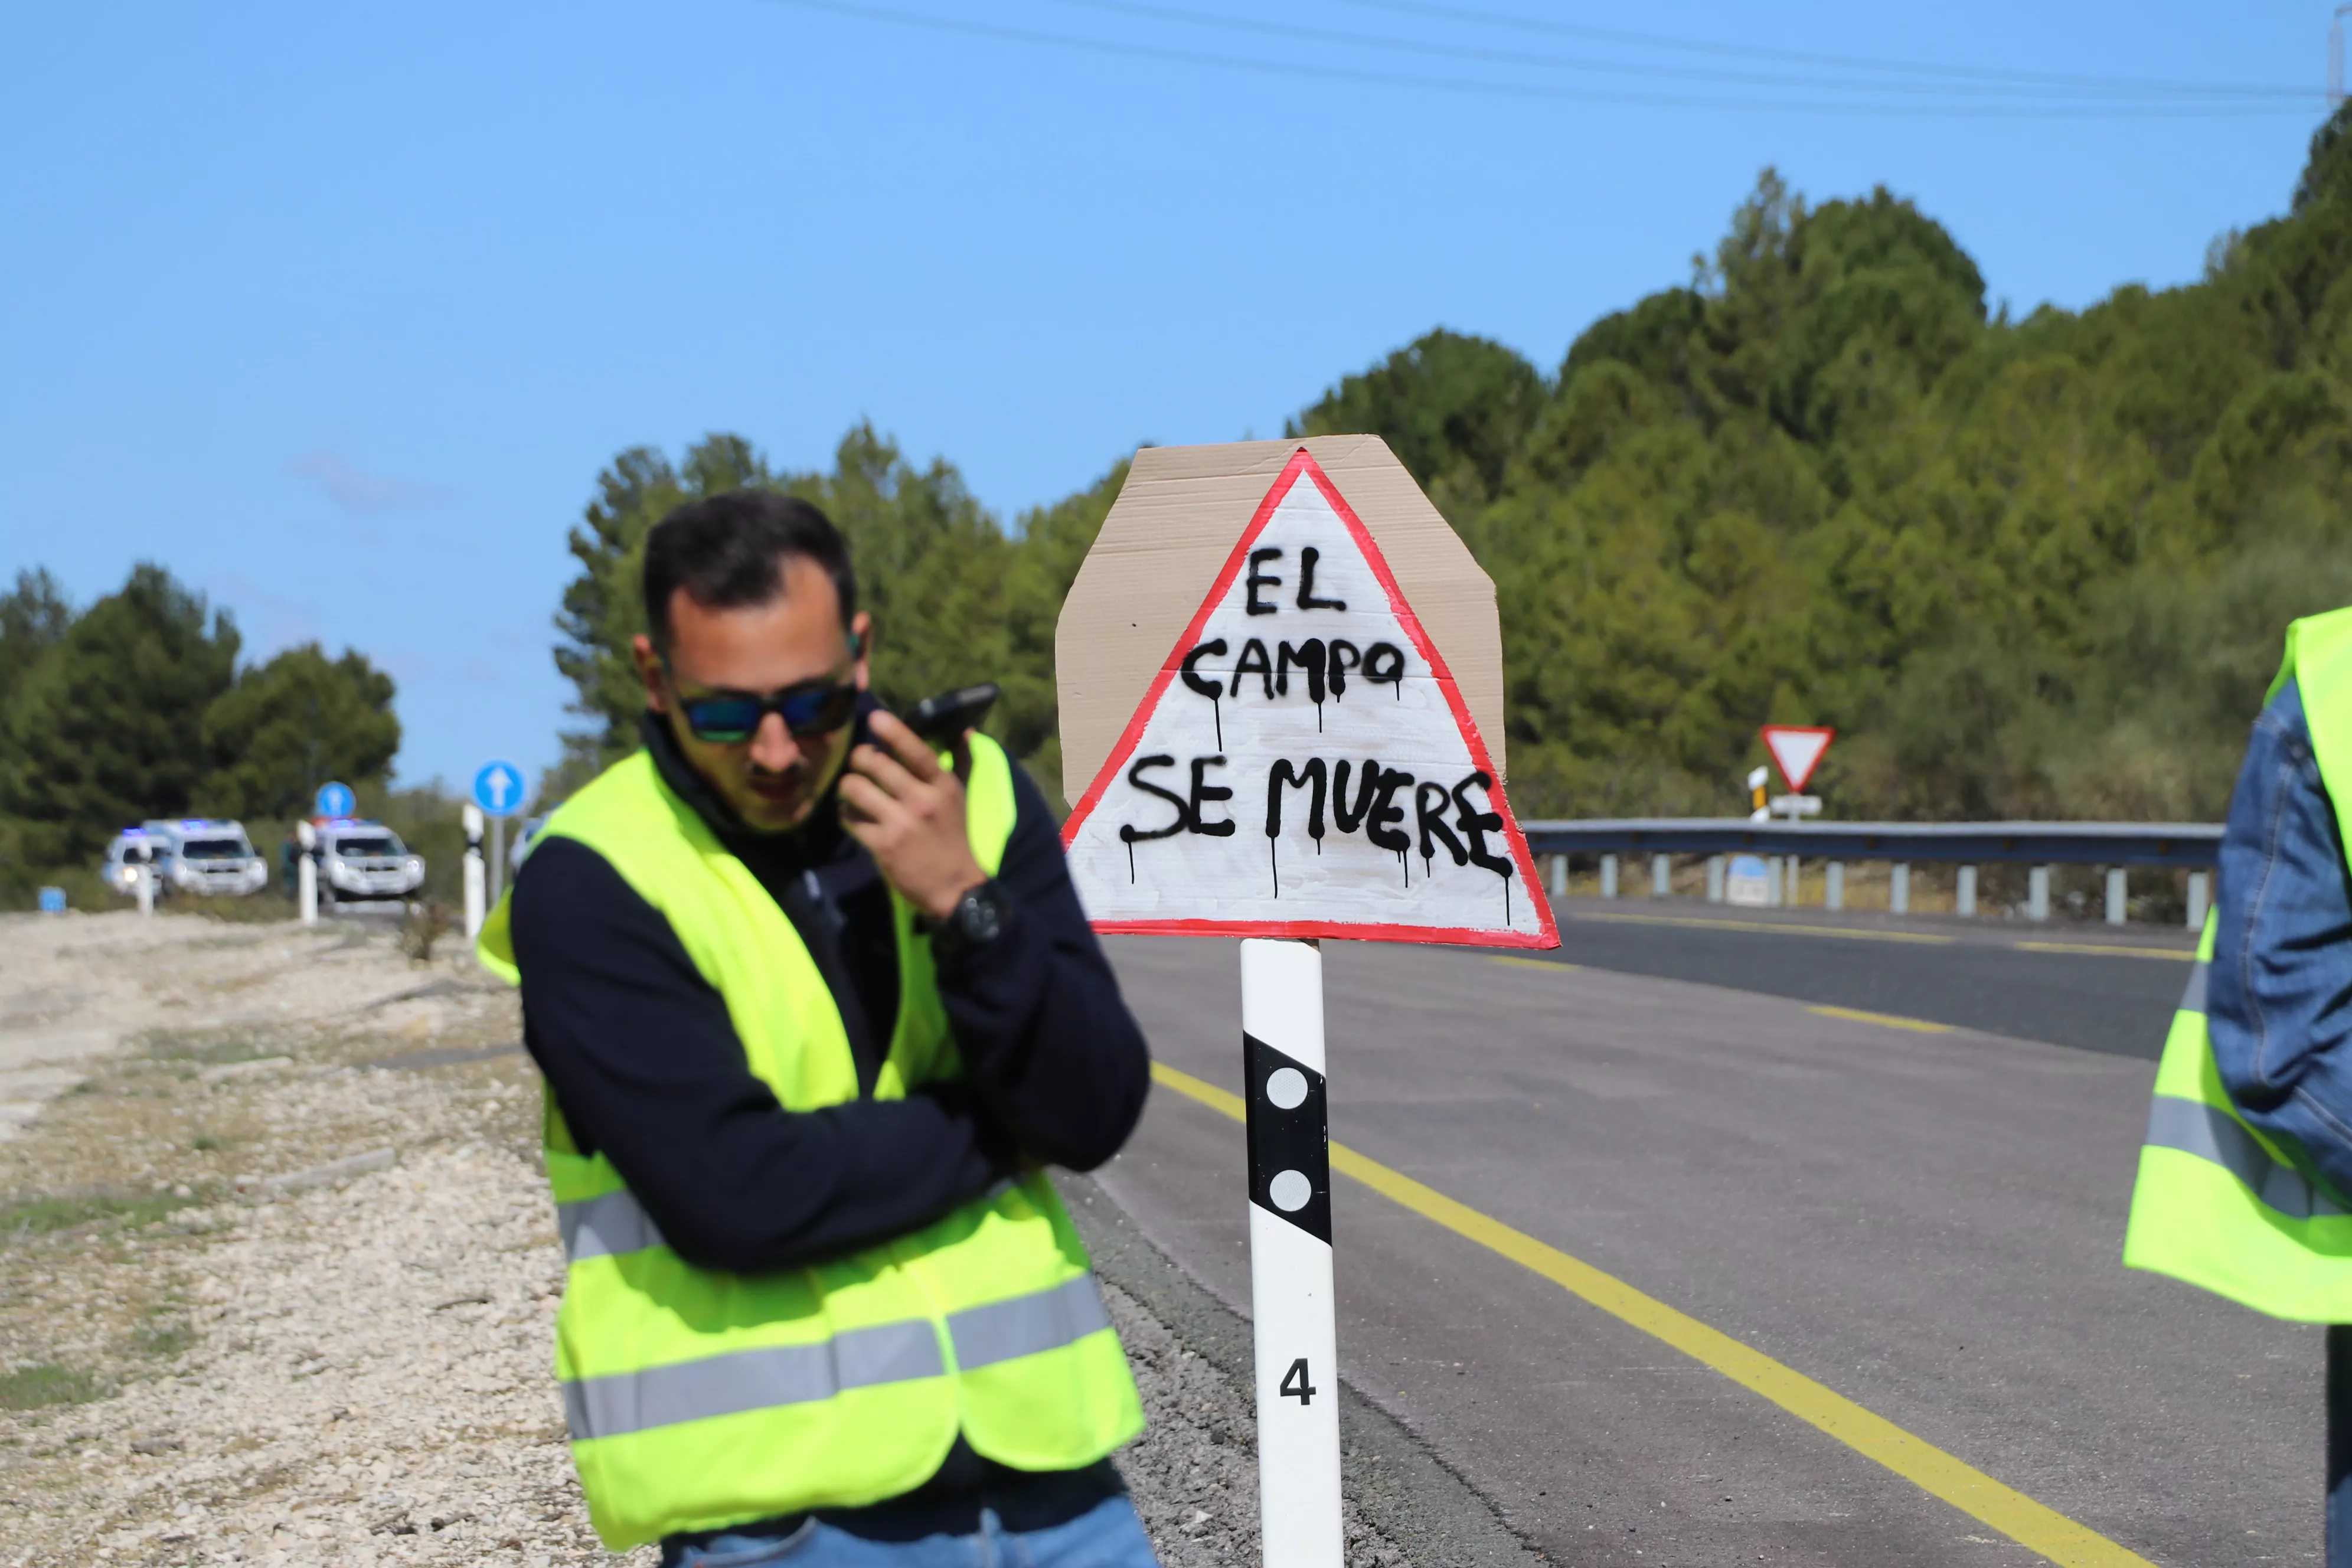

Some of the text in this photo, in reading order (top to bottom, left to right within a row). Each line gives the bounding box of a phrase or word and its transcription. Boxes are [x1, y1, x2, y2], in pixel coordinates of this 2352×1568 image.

[1246, 547, 1347, 616] EL
[1180, 637, 1406, 705] CAMPO
[1119, 753, 1514, 880] SE MUERE
[1279, 1358, 1317, 1406] 4
